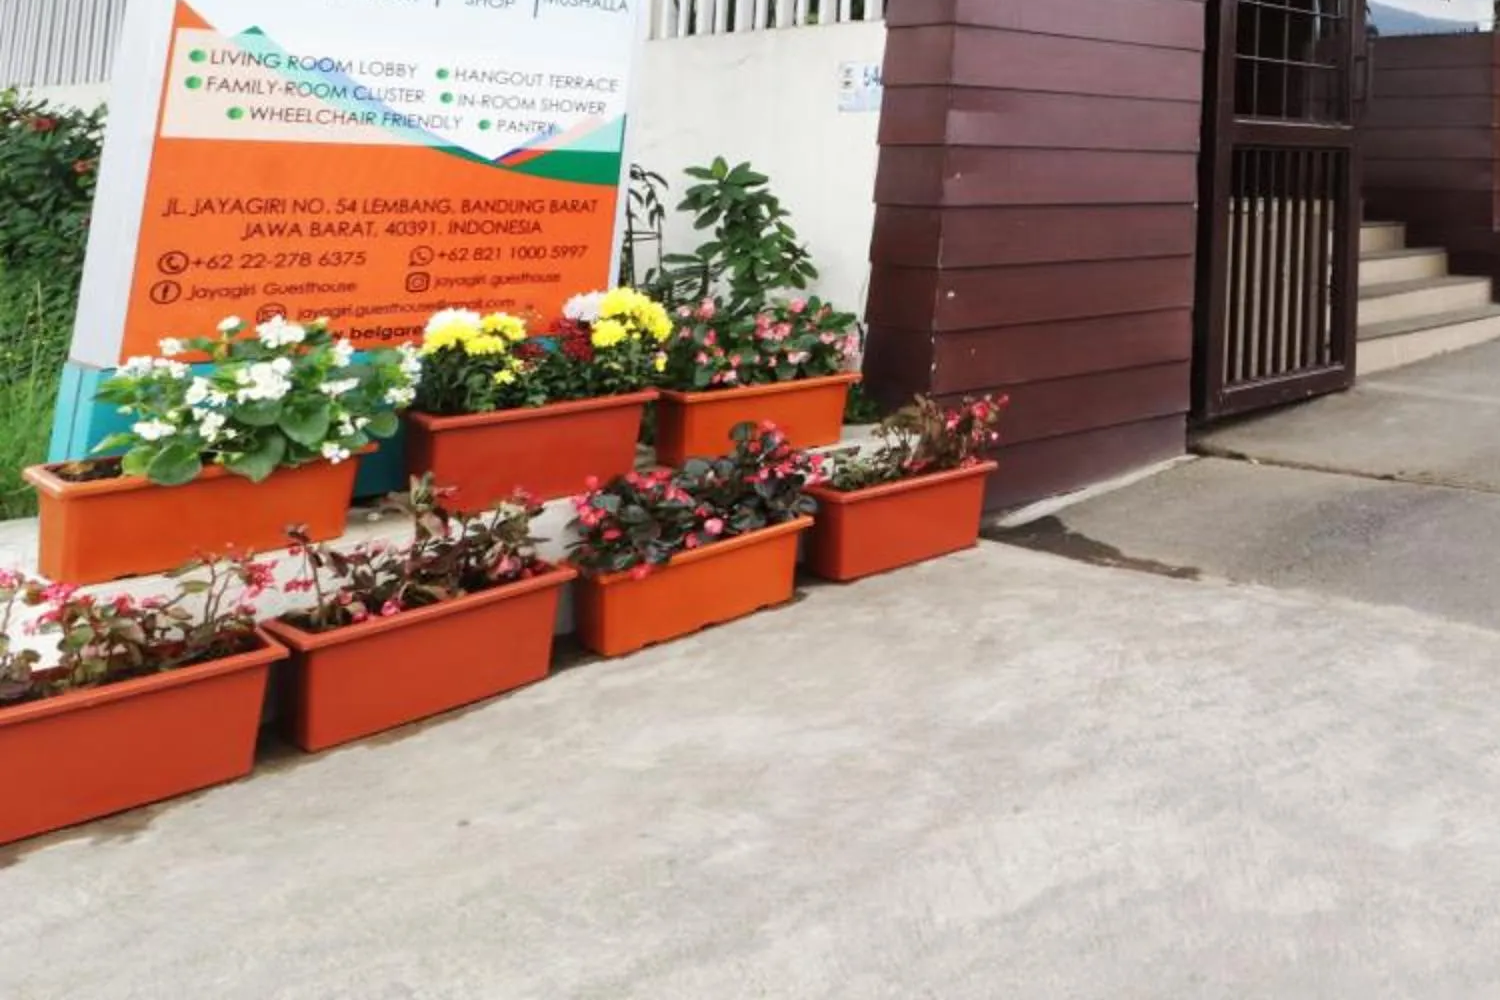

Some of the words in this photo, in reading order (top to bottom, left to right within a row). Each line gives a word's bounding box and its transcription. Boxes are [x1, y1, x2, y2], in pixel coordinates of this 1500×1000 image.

[210, 49, 281, 70] LIVING
[286, 56, 353, 75] ROOM
[358, 61, 419, 80] LOBBY
[206, 76, 347, 99] FAMILY-ROOM
[353, 86, 425, 104] CLUSTER
[454, 67, 544, 87] HANGOUT
[549, 73, 619, 93] TERRACE
[457, 93, 537, 111] IN-ROOM
[541, 99, 607, 116] SHOWER
[249, 105, 377, 127] WHEELCHAIR
[381, 112, 464, 130] FRIENDLY
[497, 119, 557, 135] PANTRY
[189, 197, 286, 217] JAYAGIRI
[336, 197, 357, 214] 54
[461, 199, 545, 215] BANDUNG
[550, 199, 599, 214] BARAT
[240, 221, 303, 241] JAWA
[447, 218, 543, 235] INDONESIA
[192, 253, 234, 270] +62
[240, 252, 312, 269] 22-278
[318, 250, 368, 266] 6375
[438, 247, 469, 262] +62
[472, 247, 501, 261] 821
[509, 246, 547, 260] 1000
[549, 244, 589, 259] 5997
[262, 281, 358, 297] Guesthouse
